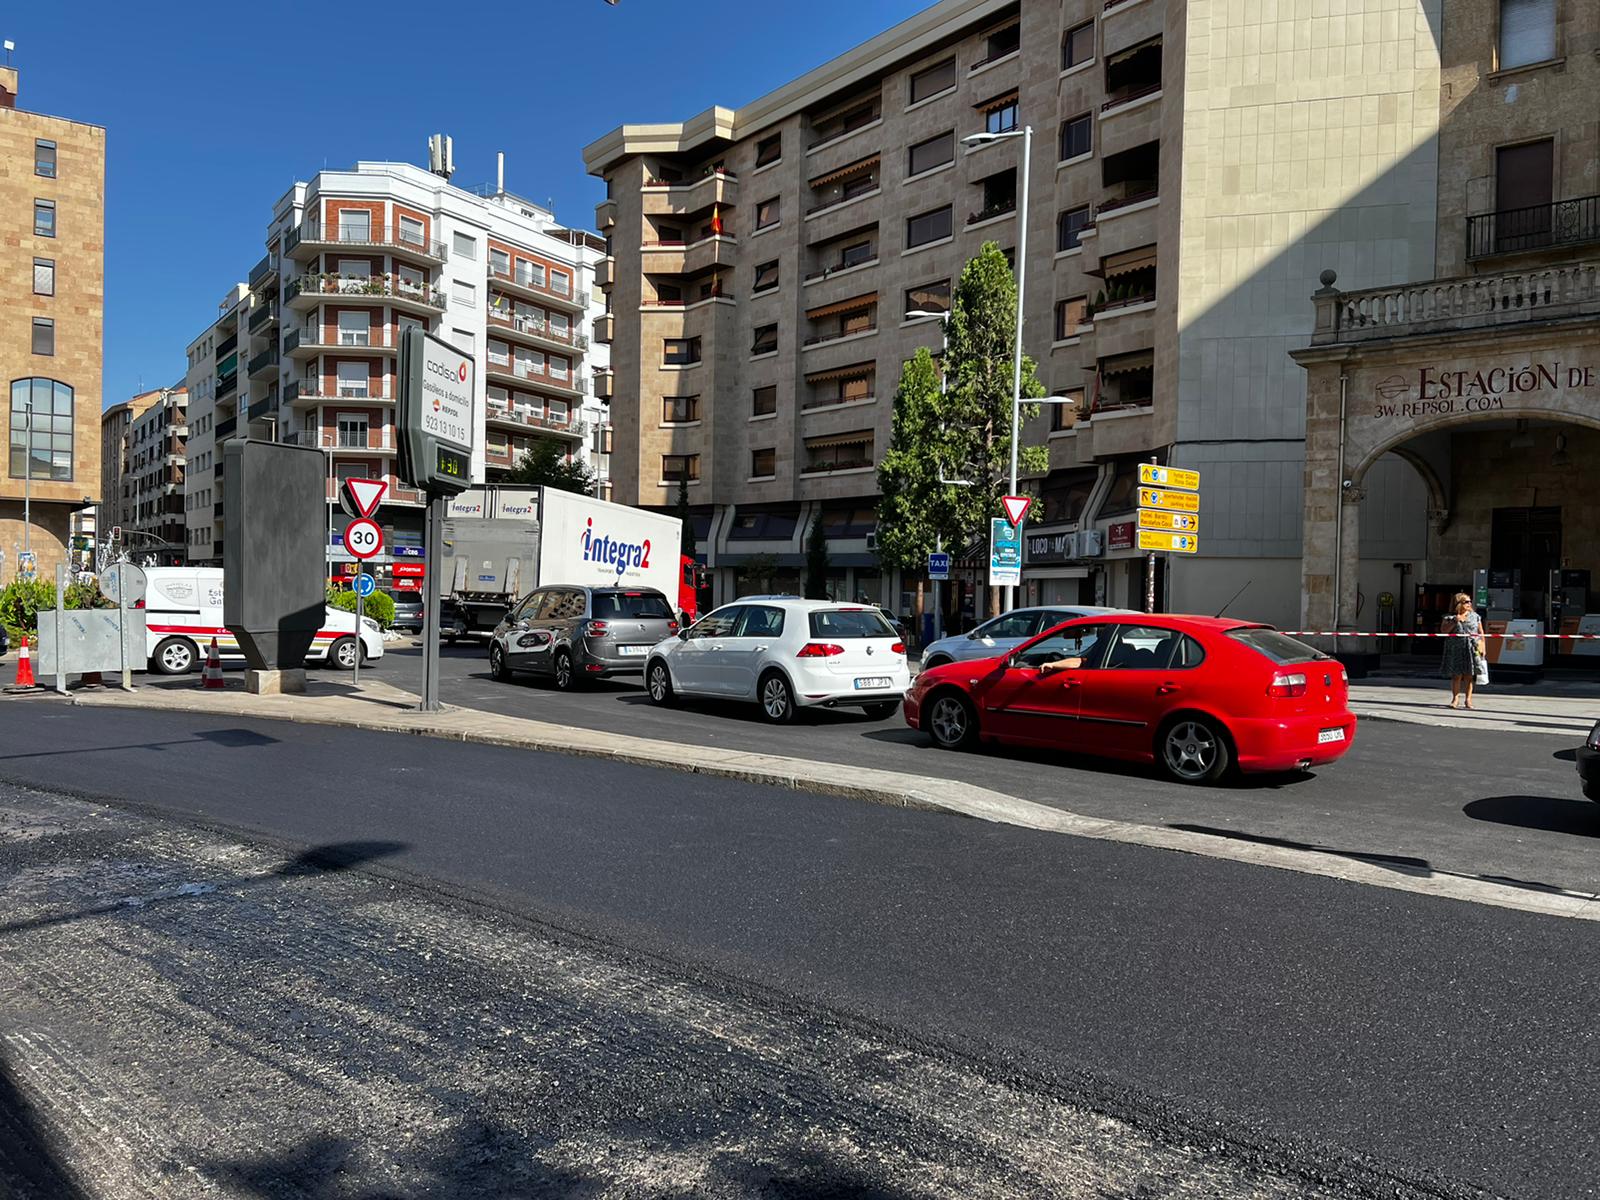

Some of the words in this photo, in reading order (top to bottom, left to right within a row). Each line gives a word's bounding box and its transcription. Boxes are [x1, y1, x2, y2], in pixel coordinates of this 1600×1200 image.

[1568, 366, 1595, 388] DE
[449, 390, 470, 408] domicilio
[426, 414, 438, 431] 923
[439, 419, 447, 435] 13
[448, 423, 456, 438] 10
[457, 427, 465, 441] 15
[452, 503, 481, 514] integra2
[502, 503, 532, 514] integra2
[353, 531, 374, 545] 30
[582, 517, 651, 576] integra2
[1032, 538, 1048, 555] LOCO
